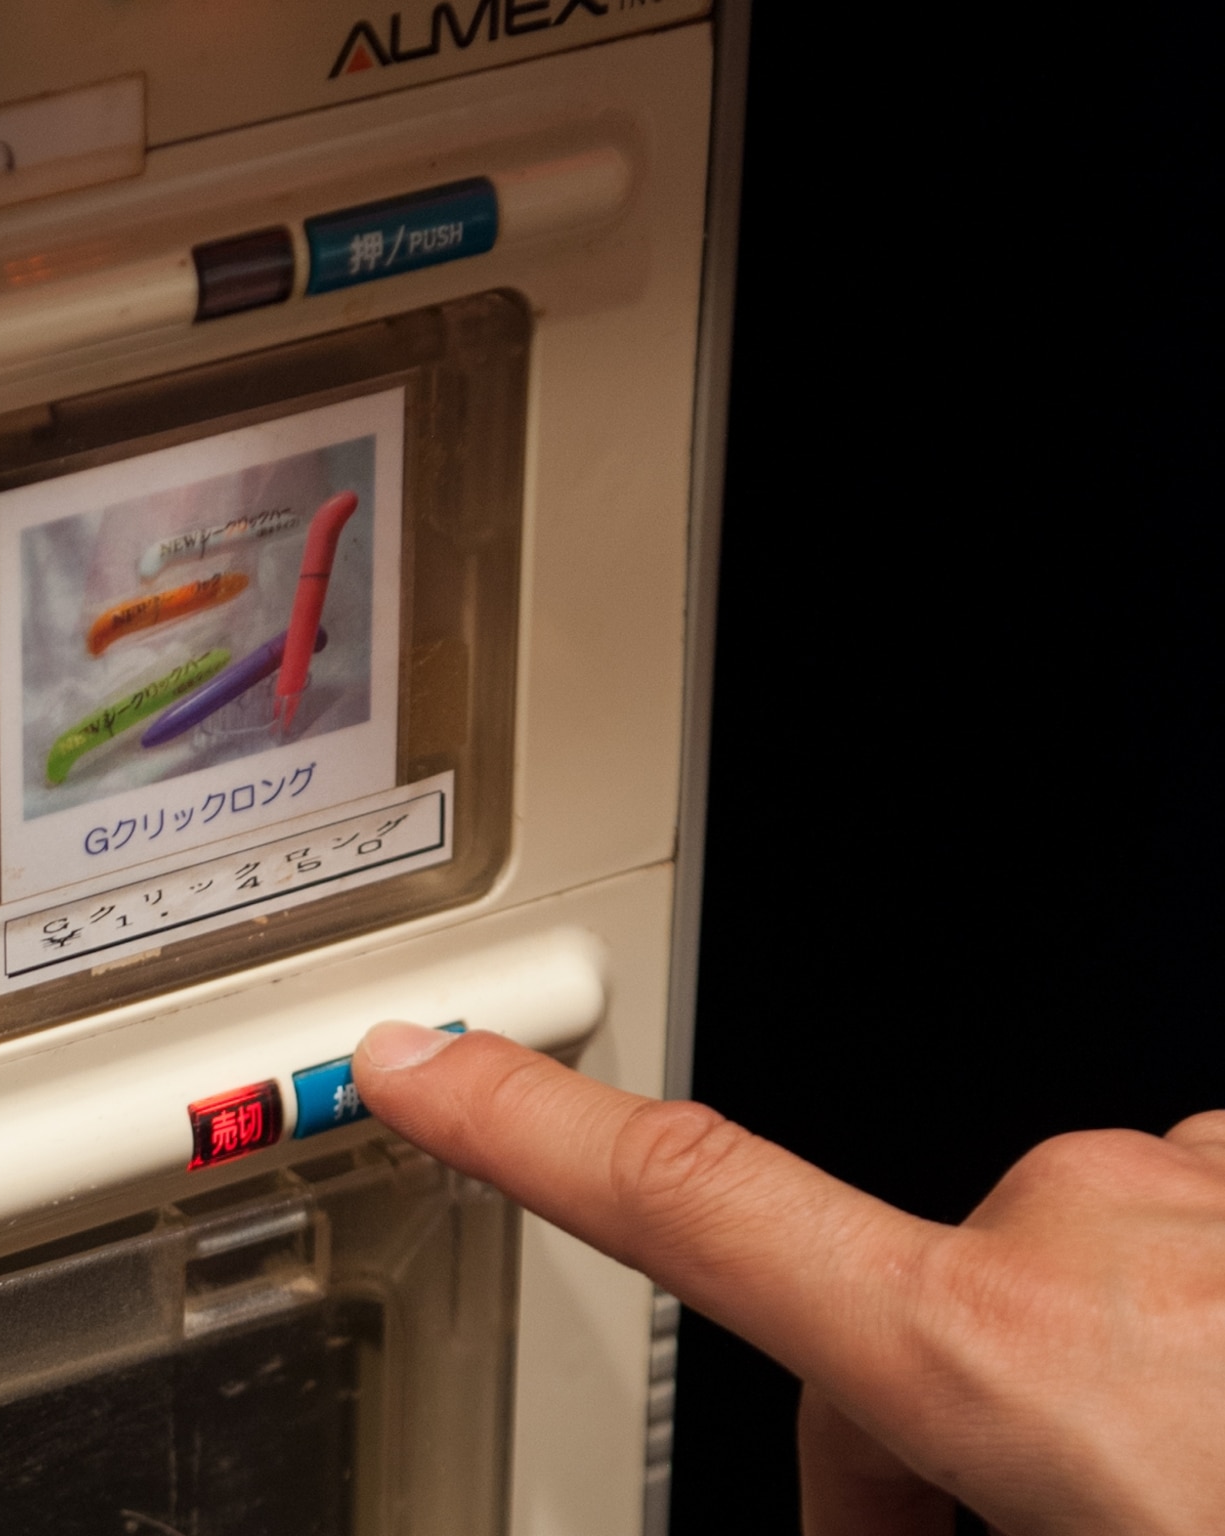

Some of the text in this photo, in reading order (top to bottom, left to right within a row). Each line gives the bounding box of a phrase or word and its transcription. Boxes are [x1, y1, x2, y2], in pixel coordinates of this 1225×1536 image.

[83, 762, 318, 857] Gクリックロング
[210, 1101, 263, 1157] 売切
